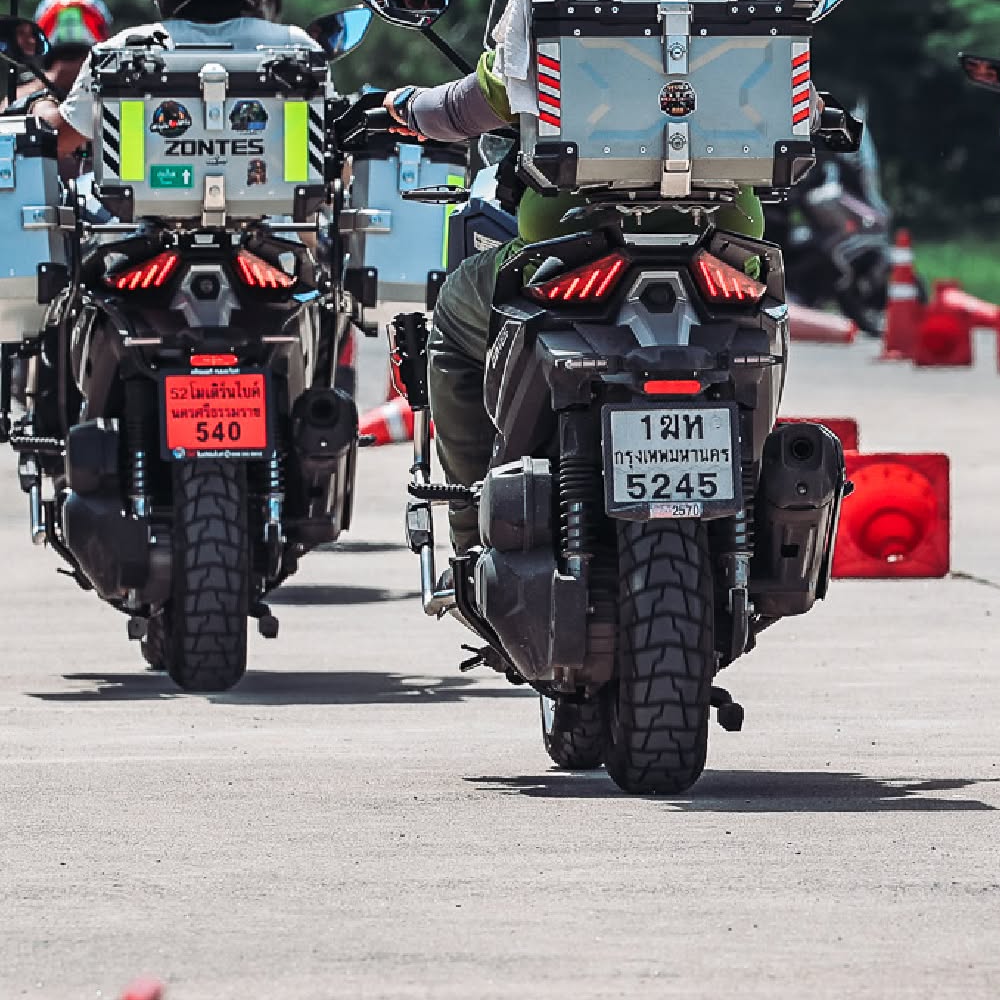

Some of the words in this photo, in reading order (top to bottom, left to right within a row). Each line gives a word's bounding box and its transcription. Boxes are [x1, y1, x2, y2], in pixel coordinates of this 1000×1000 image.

[164, 139, 264, 156] ZONTES
[197, 422, 241, 442] 540
[615, 449, 730, 468] กรุงเทพมหานคร
[627, 473, 718, 499] 5245
[672, 505, 699, 516] 2570
